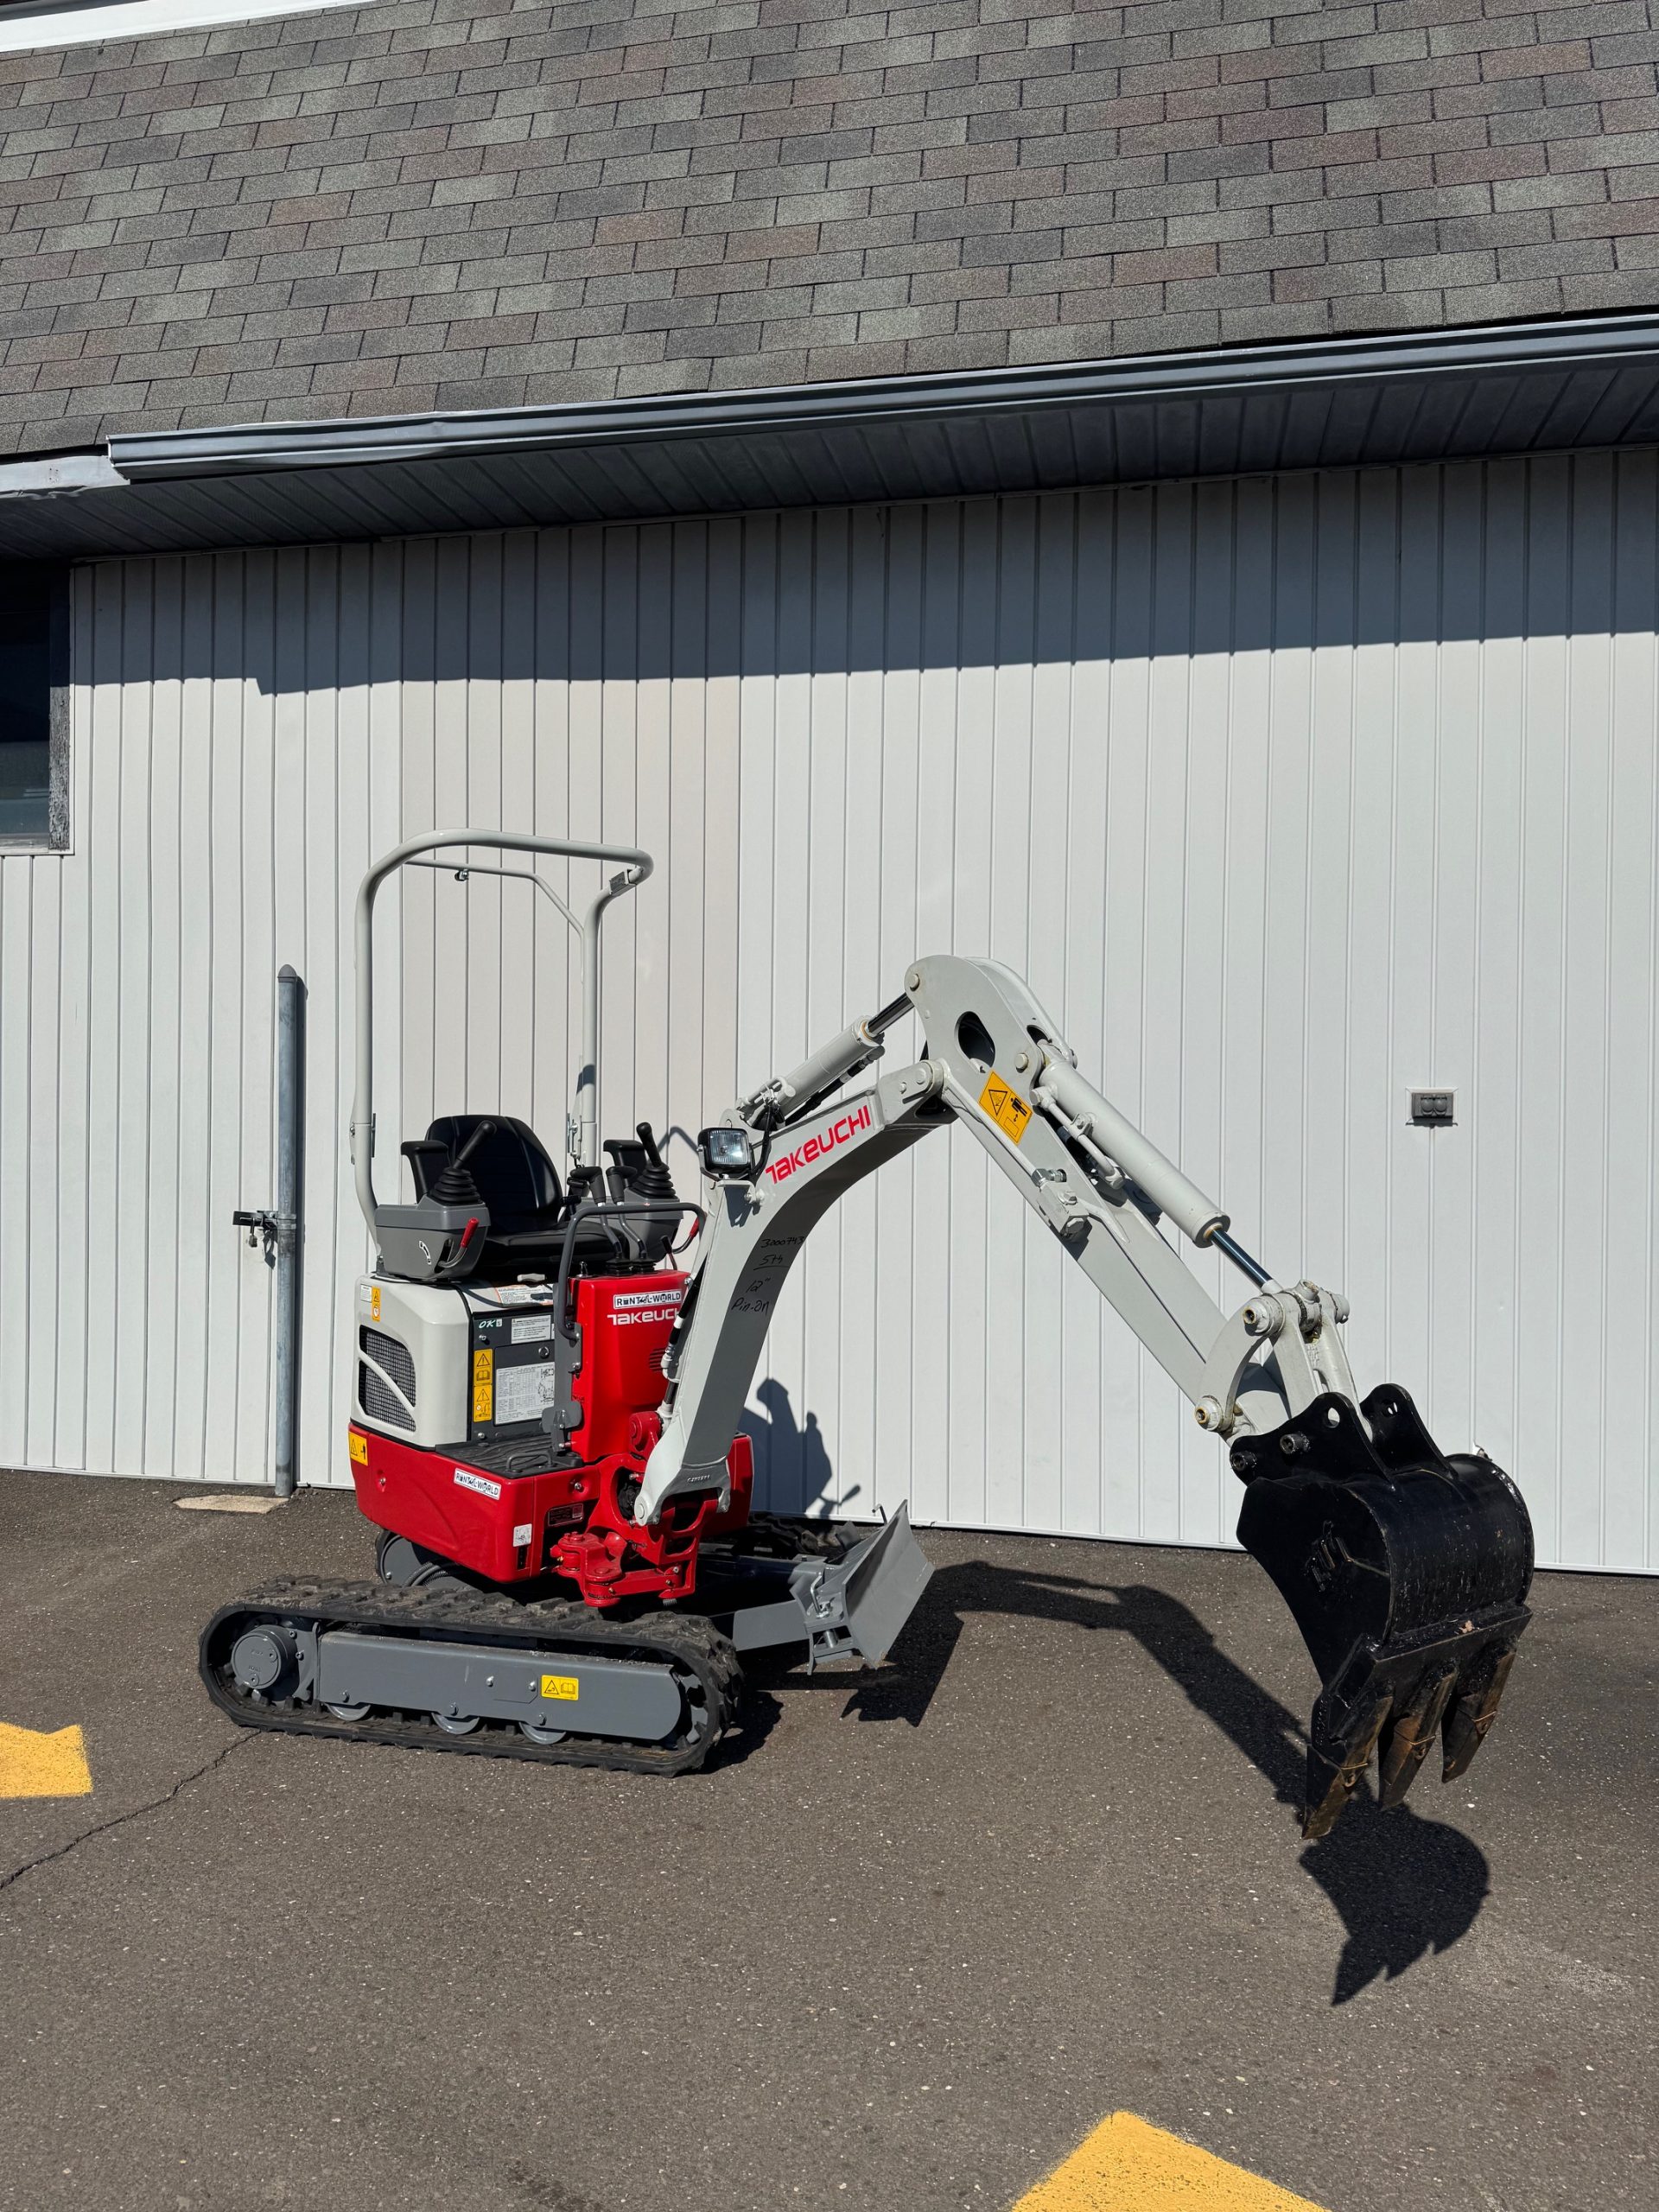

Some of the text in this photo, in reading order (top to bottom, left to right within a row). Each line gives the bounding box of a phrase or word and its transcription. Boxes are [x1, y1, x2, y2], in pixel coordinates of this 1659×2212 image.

[765, 1105, 871, 1185] TAKEUCHI
[478, 1319, 496, 1329] OK
[607, 1308, 680, 1325] TAKEUC
